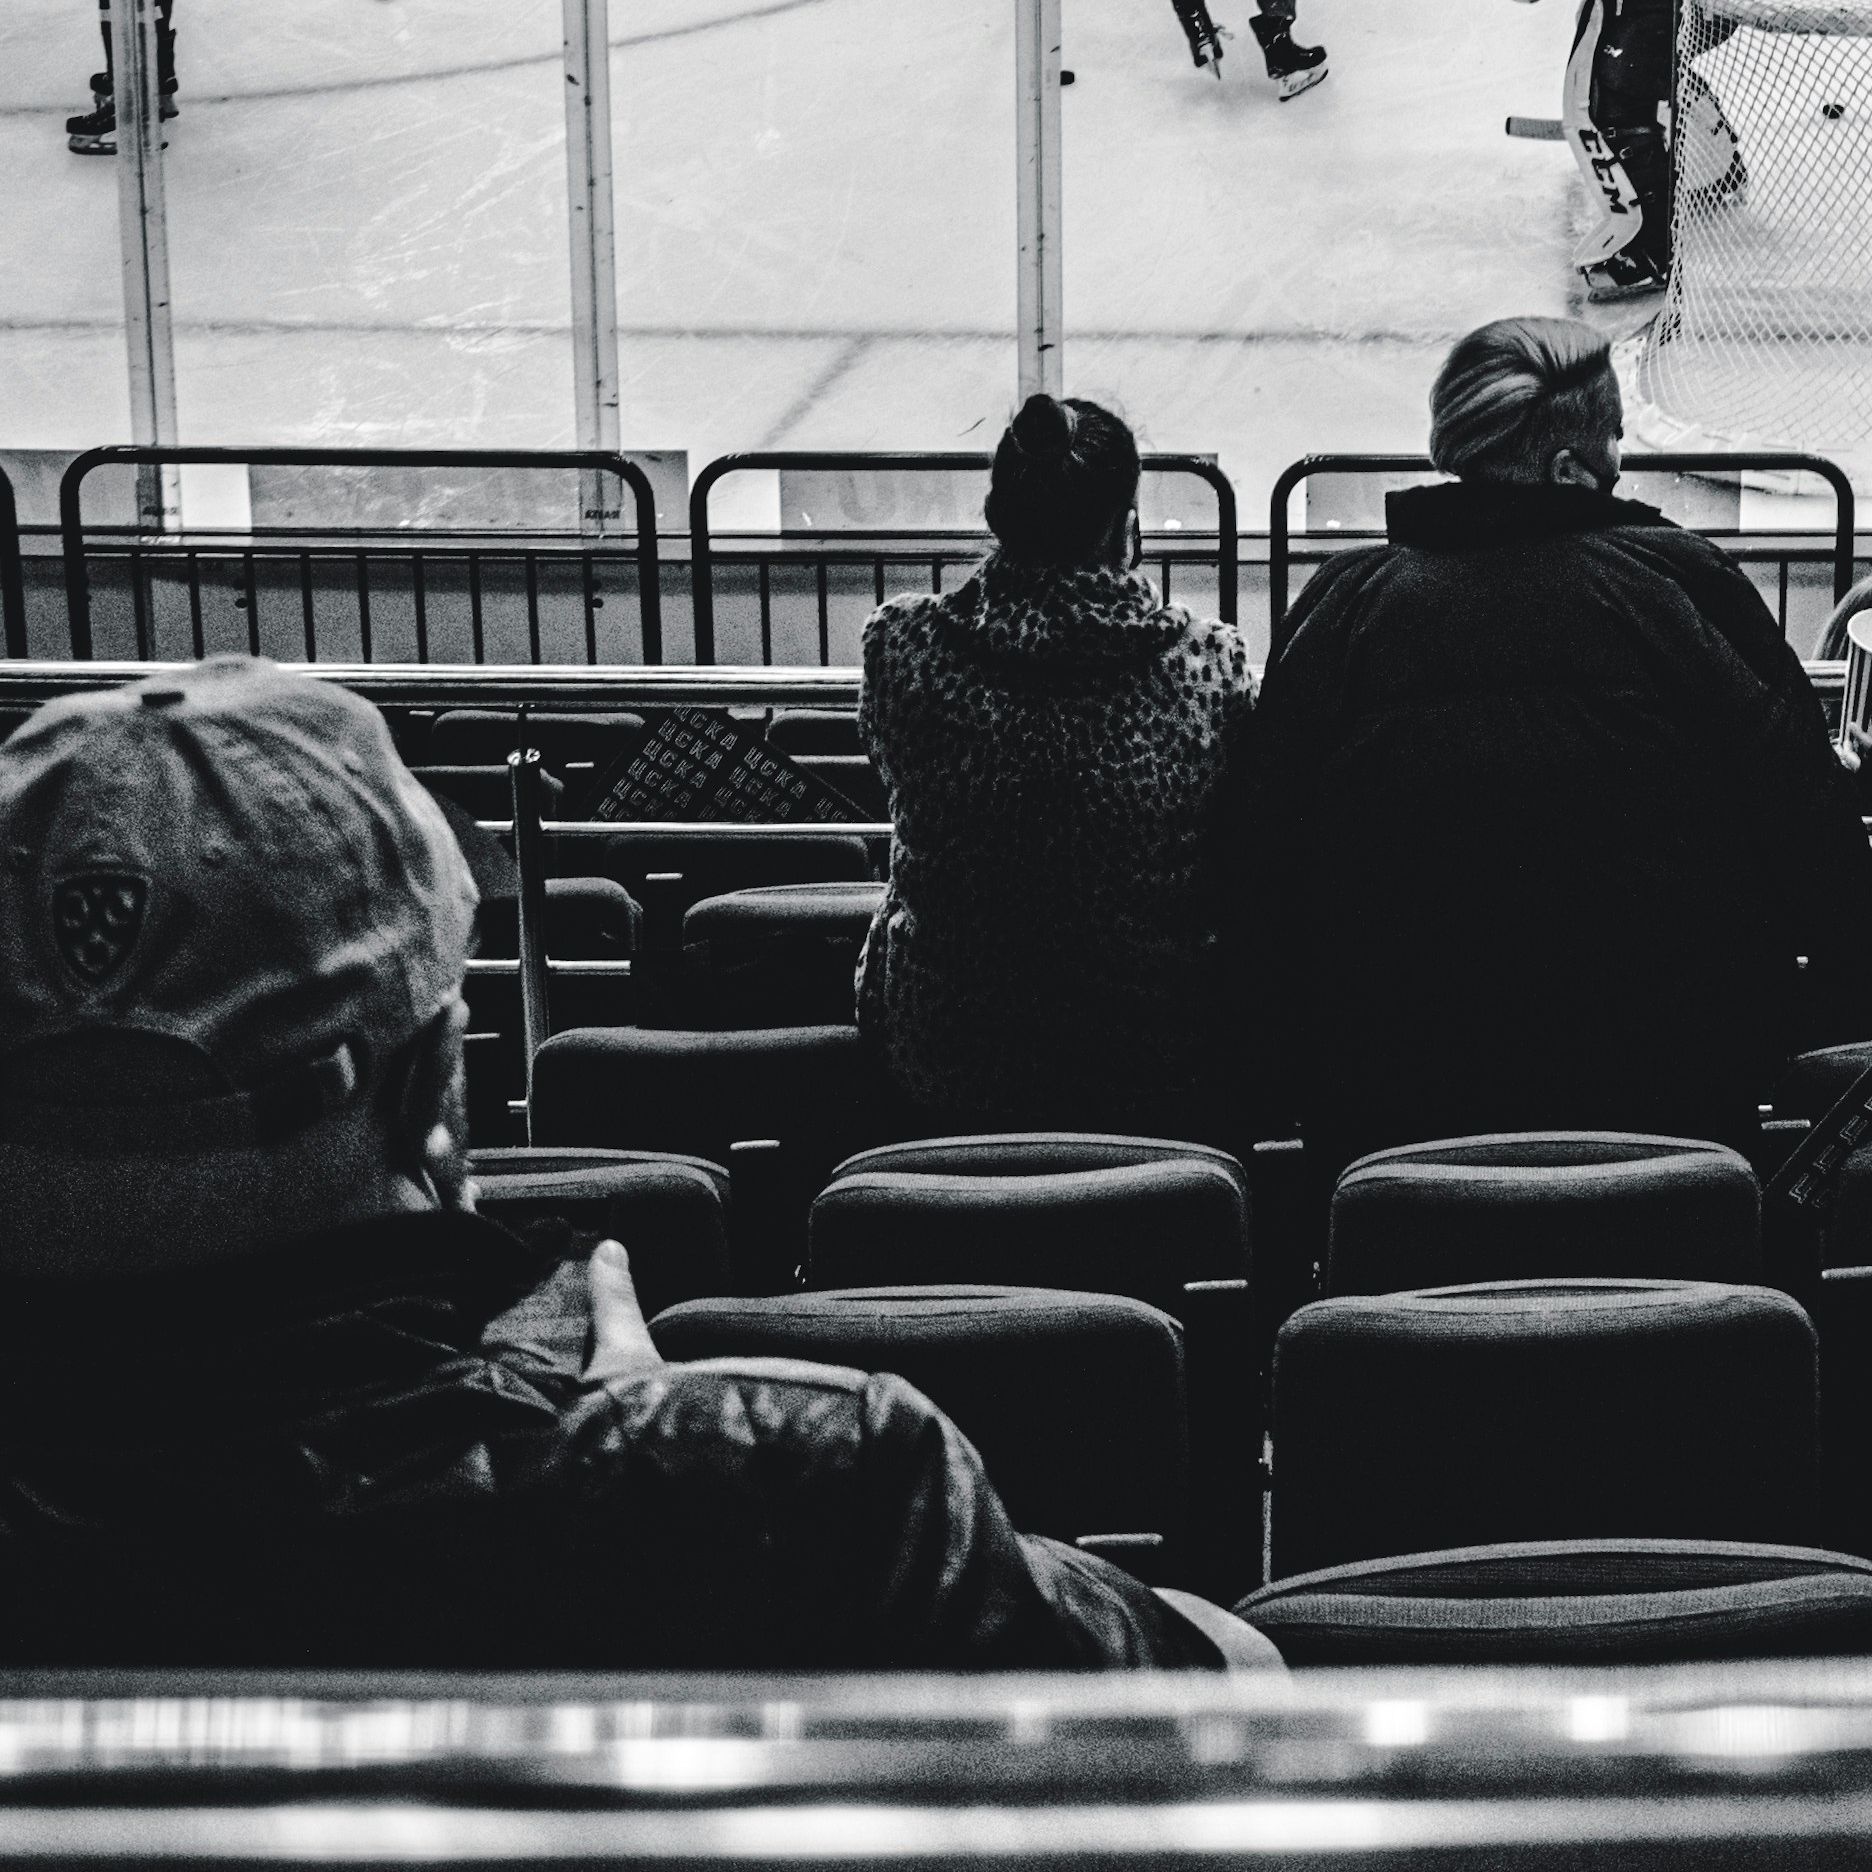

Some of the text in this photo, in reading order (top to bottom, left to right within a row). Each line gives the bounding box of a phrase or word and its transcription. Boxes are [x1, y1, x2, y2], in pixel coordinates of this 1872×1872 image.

[642, 738, 708, 789] ЦСКА
[658, 719, 722, 769] ЦСКА
[628, 757, 691, 809] ЦСКА
[744, 746, 807, 799] ЦСКА
